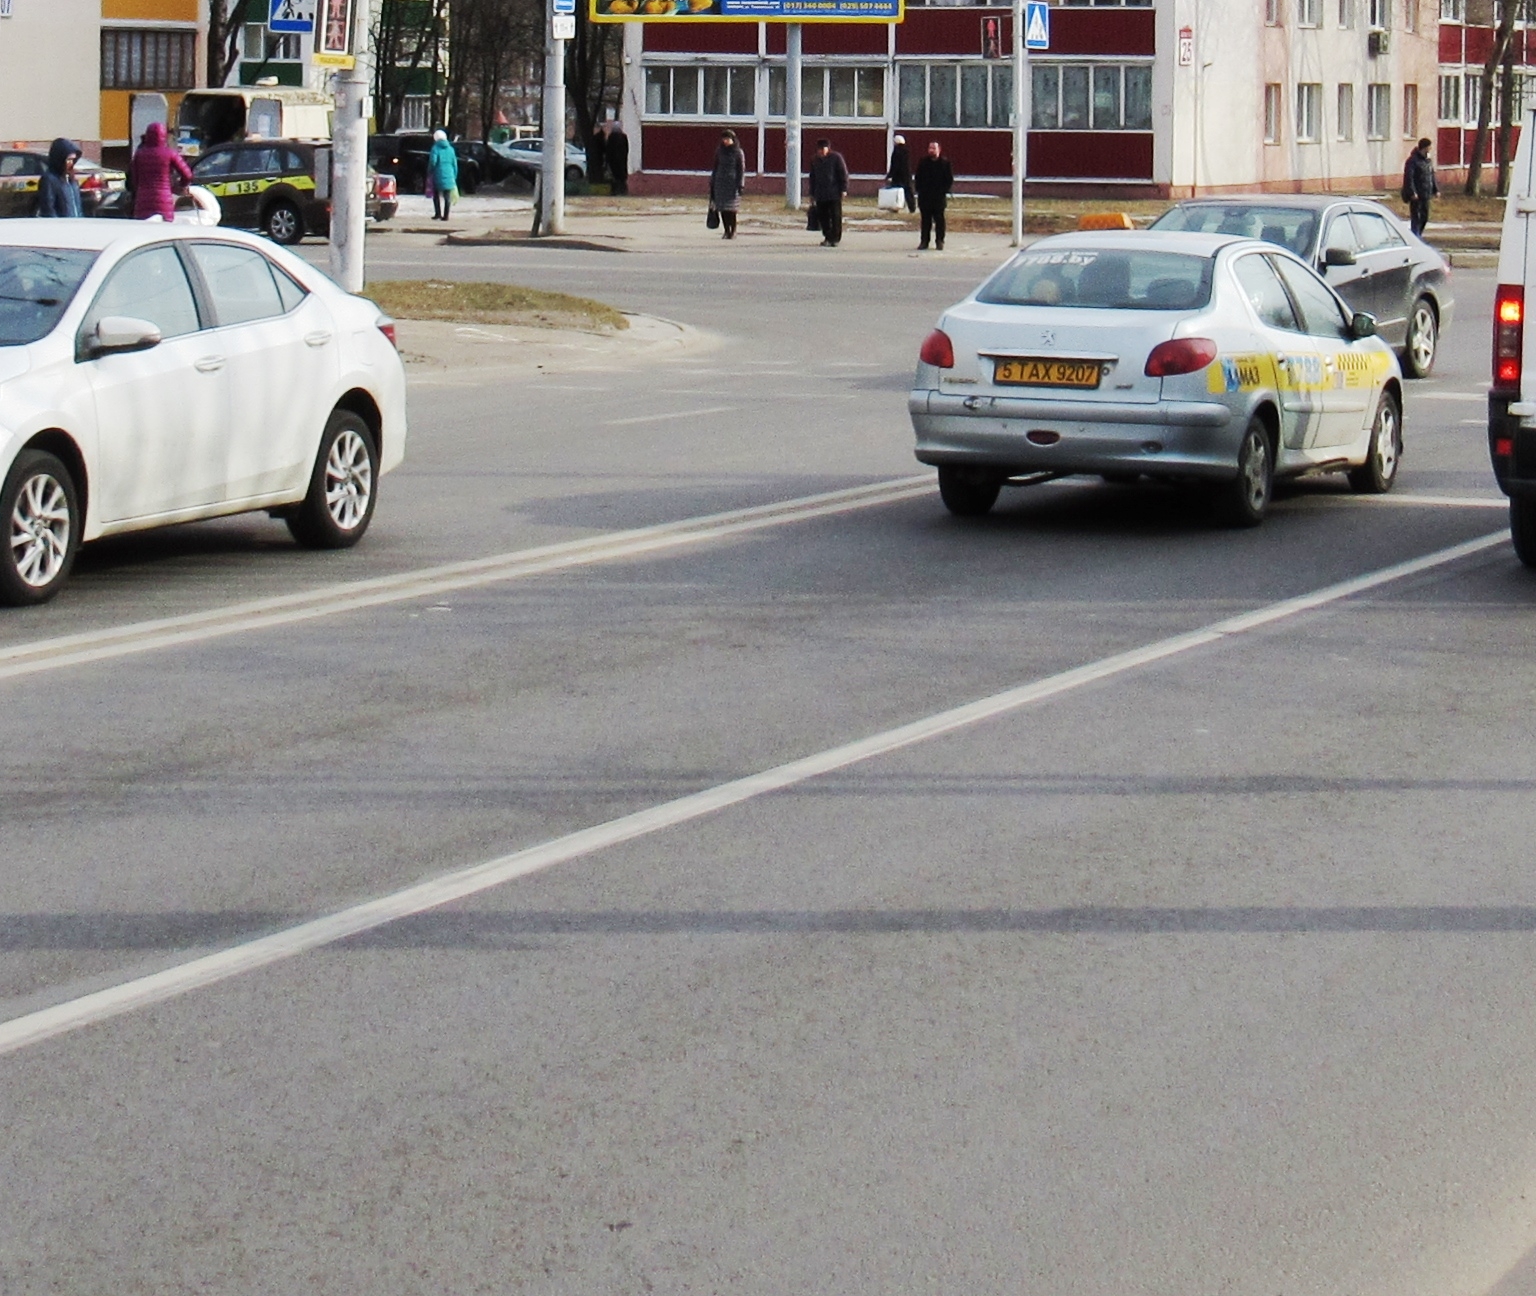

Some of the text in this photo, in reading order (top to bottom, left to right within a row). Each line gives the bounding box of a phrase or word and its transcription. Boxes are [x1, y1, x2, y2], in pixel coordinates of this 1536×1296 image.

[237, 181, 259, 193] 135
[1002, 363, 1095, 382] 5 TAX 9207
